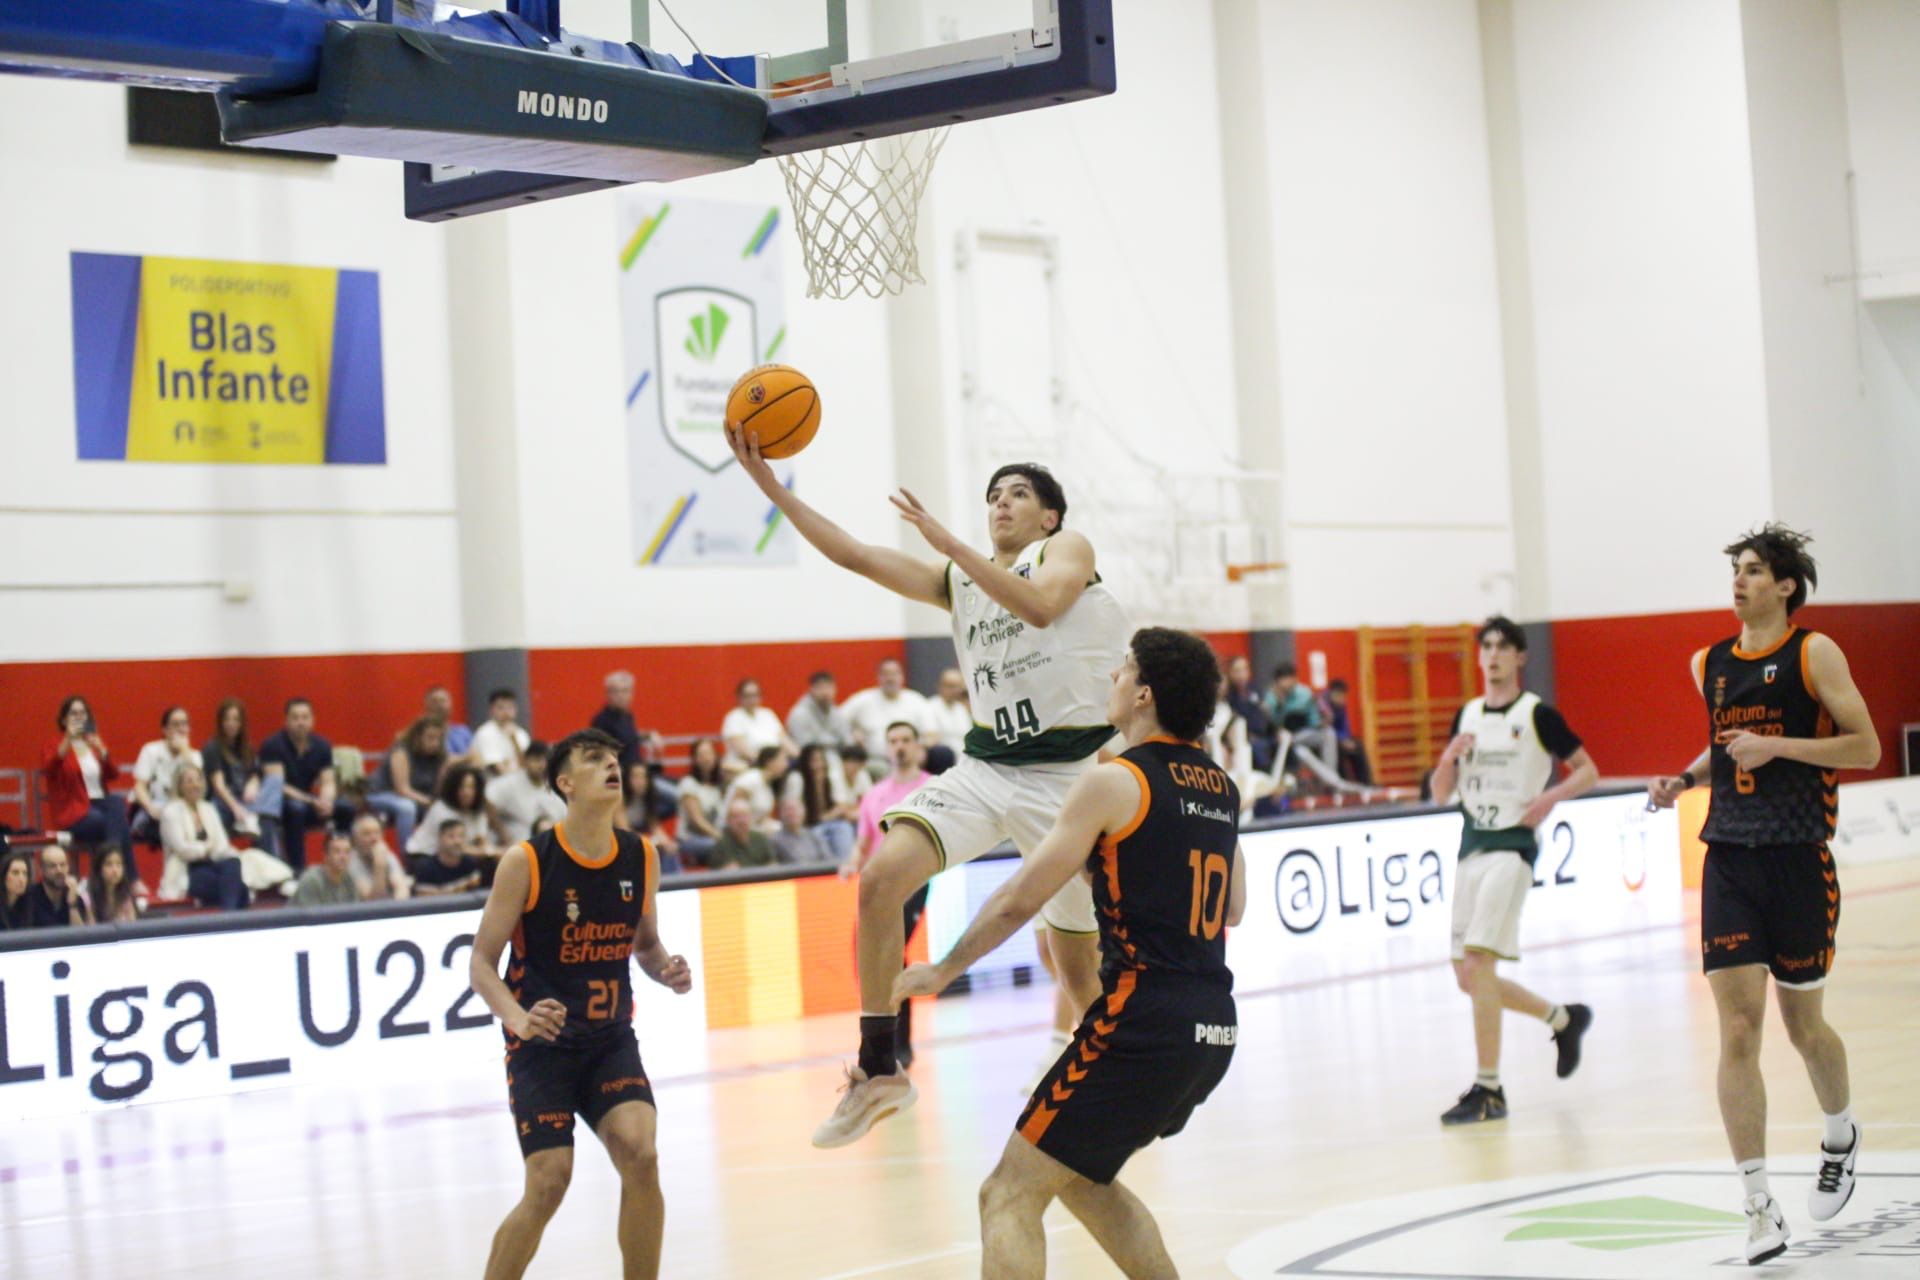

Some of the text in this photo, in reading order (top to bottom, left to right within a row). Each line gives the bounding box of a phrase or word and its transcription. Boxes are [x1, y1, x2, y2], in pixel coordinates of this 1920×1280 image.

[517, 90, 608, 124] MONDO
[169, 273, 291, 298] POLIDEPORTIVO
[189, 311, 276, 354] Blas
[157, 359, 310, 404] Infante
[993, 697, 1042, 745] 44
[1168, 762, 1230, 796] CAROT
[1735, 762, 1755, 795] 6
[1475, 805, 1500, 827] 22
[1188, 849, 1229, 941] 10
[561, 919, 626, 942] Cultura
[586, 979, 620, 1020] 21
